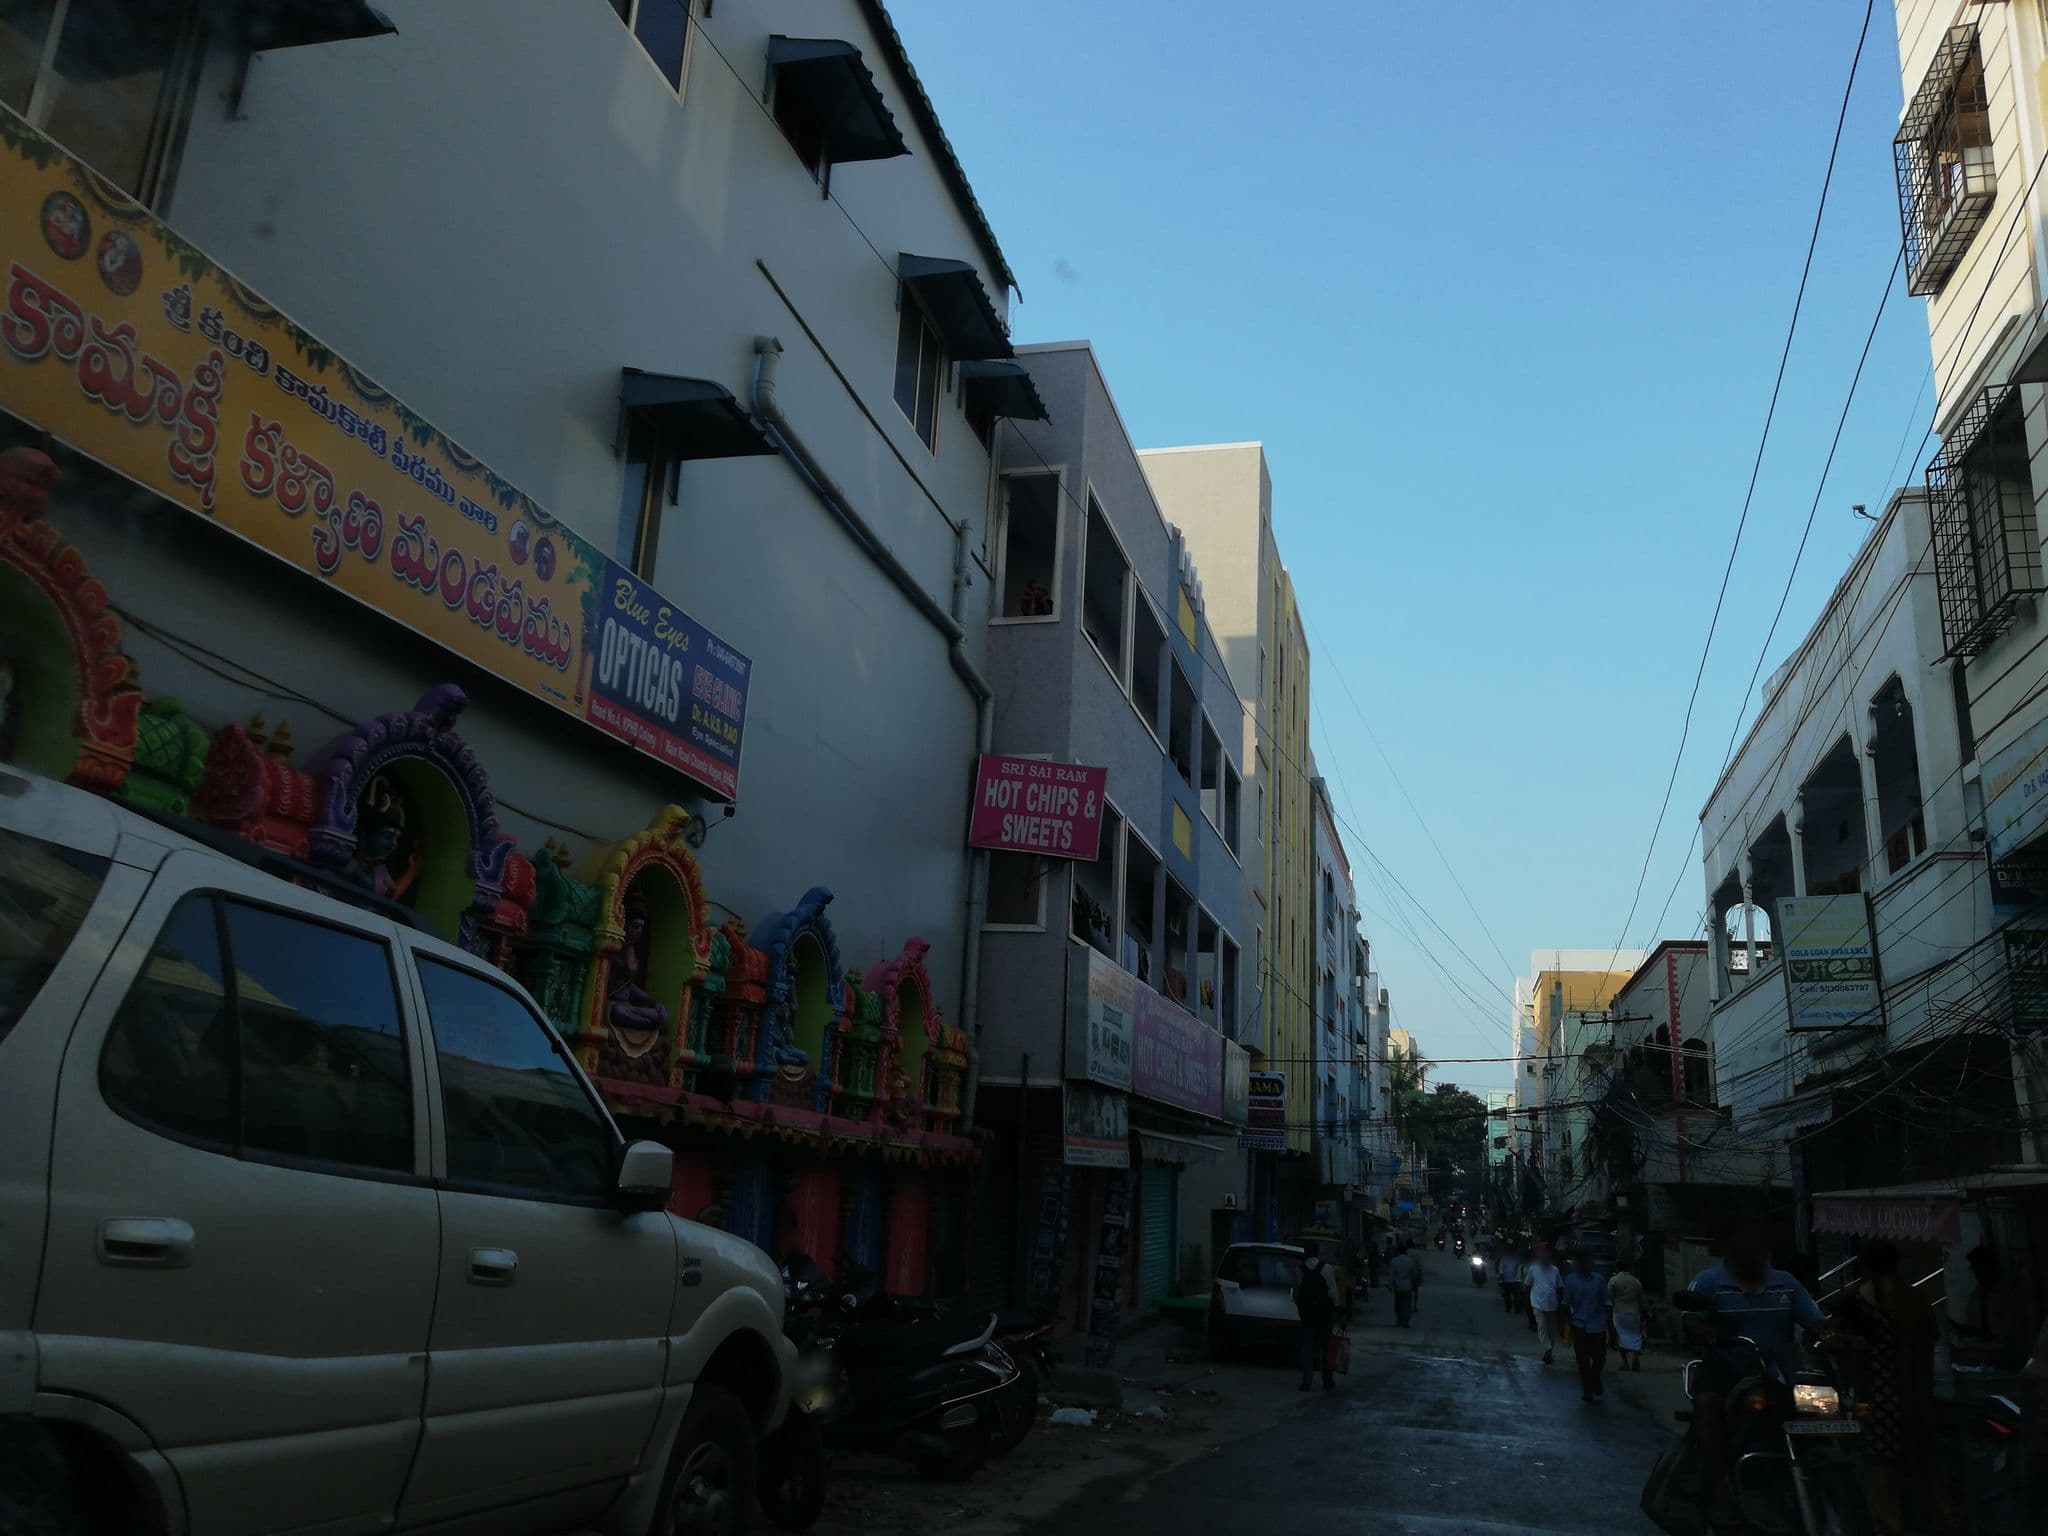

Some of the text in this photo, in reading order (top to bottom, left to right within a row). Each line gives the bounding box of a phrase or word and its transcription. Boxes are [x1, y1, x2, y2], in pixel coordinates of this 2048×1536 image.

[161, 283, 500, 535] శ్రీ కంచి కామకోటి పీఠము వారి
[239, 411, 387, 574] కళ్యాణ
[389, 511, 574, 672] మండపము
[614, 577, 689, 652] Blue Eyes
[599, 616, 682, 724] OPTICAS
[984, 778, 1097, 820] HOT CHIPS &
[1001, 763, 1088, 784] SRI SAI RAM
[1001, 813, 1073, 849] SWEETS
[1790, 948, 1809, 957] GOLD
[1811, 948, 1829, 956] LOAN
